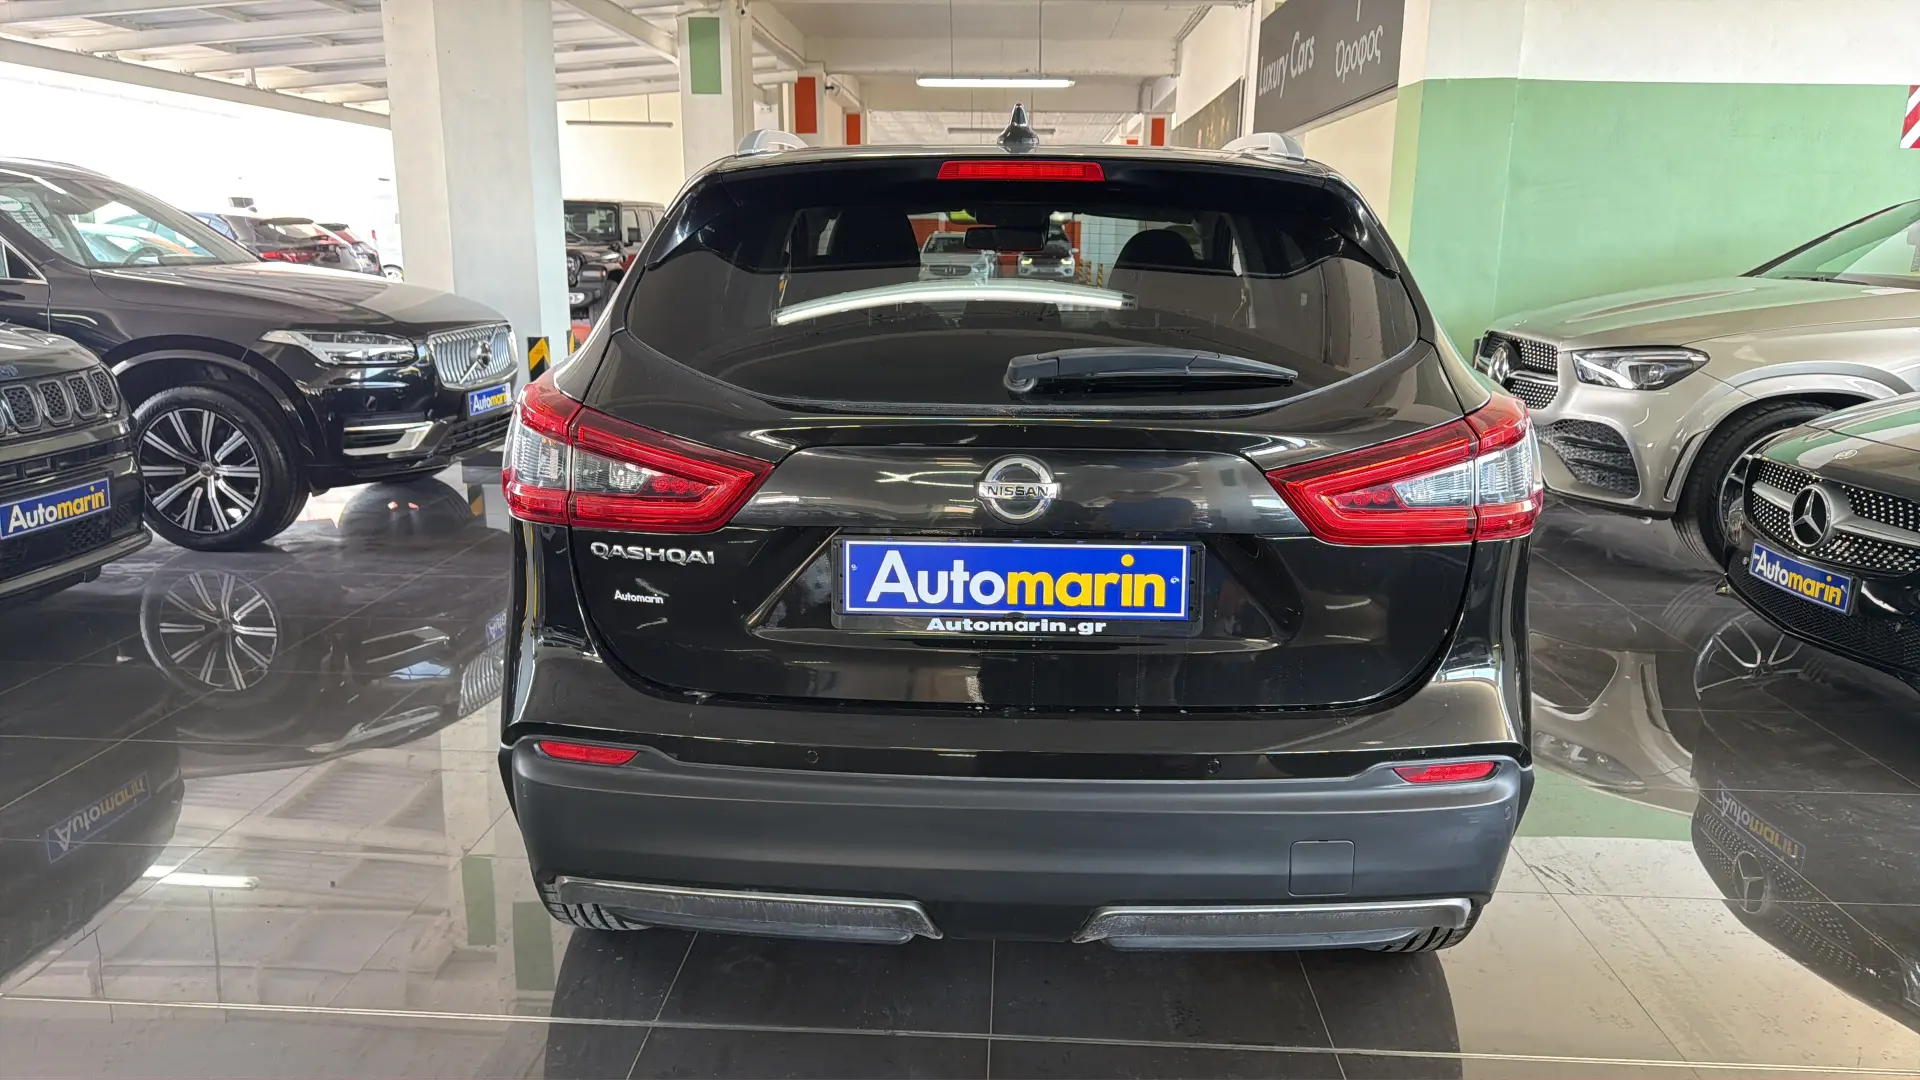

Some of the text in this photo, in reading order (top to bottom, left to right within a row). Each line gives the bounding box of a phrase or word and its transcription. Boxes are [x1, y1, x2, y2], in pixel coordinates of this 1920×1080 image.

[1259, 30, 1315, 98] Luxury Cars
[987, 485, 1049, 497] NISSAN
[8, 486, 105, 533] Automarin
[590, 541, 715, 566] QASHQAI
[865, 550, 1166, 607] Automarin
[1755, 550, 1842, 606] Automarin
[614, 589, 664, 604] Automarin
[926, 617, 1106, 635] Automarin.gr
